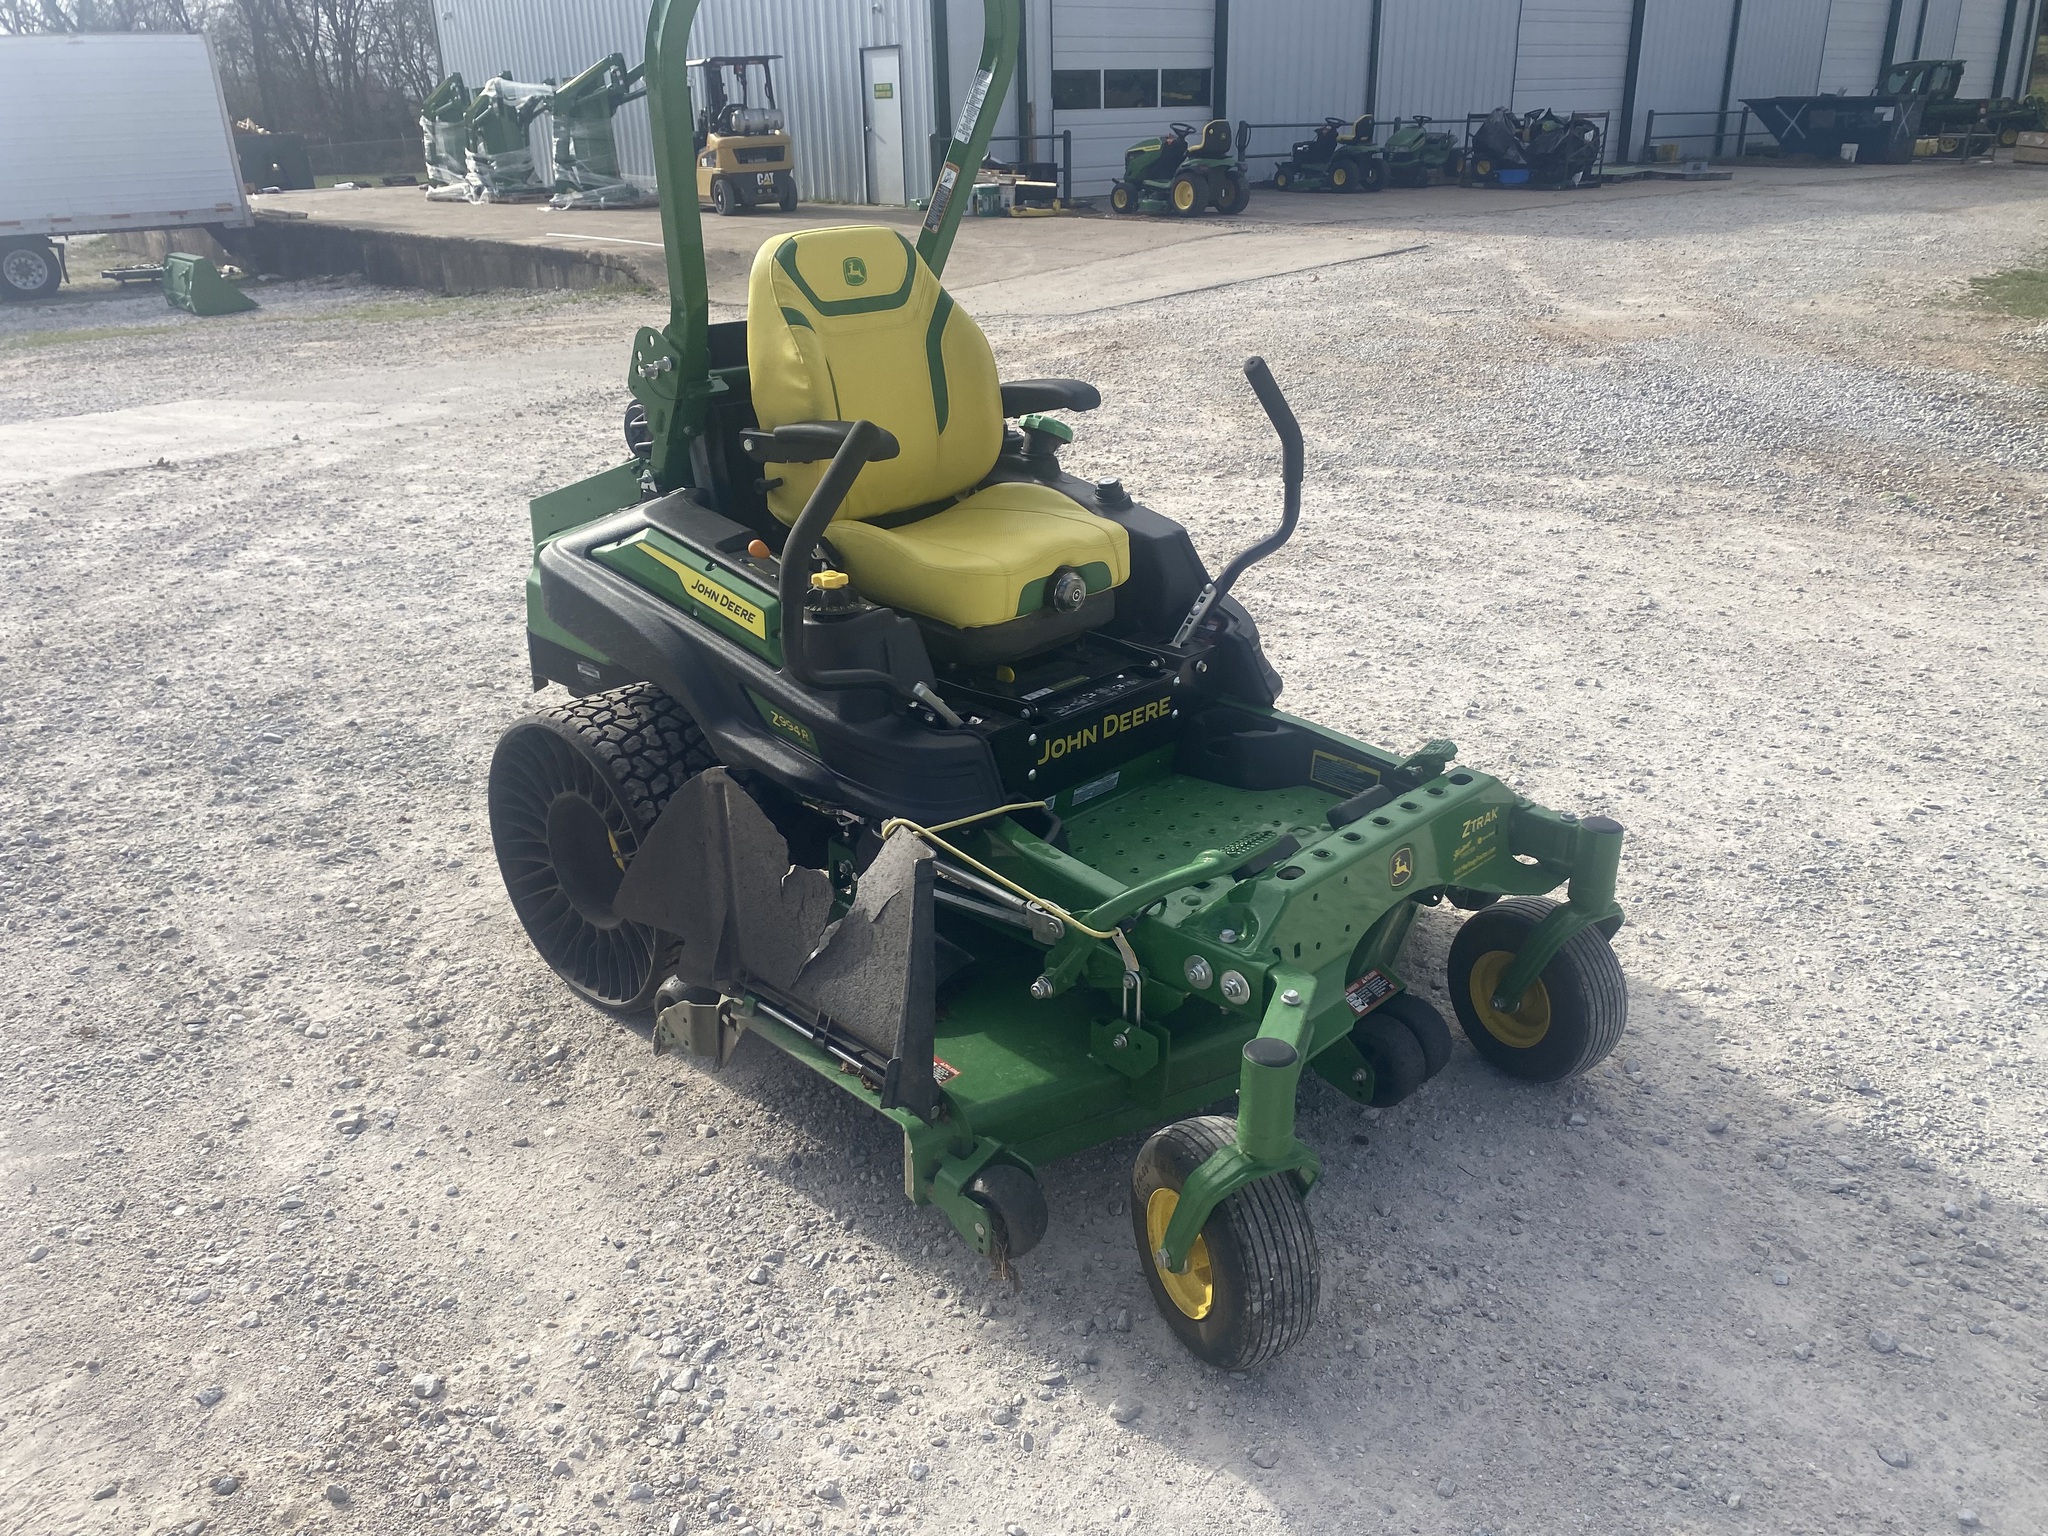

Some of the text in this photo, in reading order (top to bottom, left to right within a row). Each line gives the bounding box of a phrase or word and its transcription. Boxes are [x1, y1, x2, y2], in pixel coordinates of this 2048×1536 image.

[757, 172, 774, 186] CAT
[691, 579, 756, 624] JOHN DEERE
[770, 710, 810, 741] Z994R
[1037, 696, 1171, 766] JOHN DEERE
[1462, 806, 1499, 839] ZTRAK
